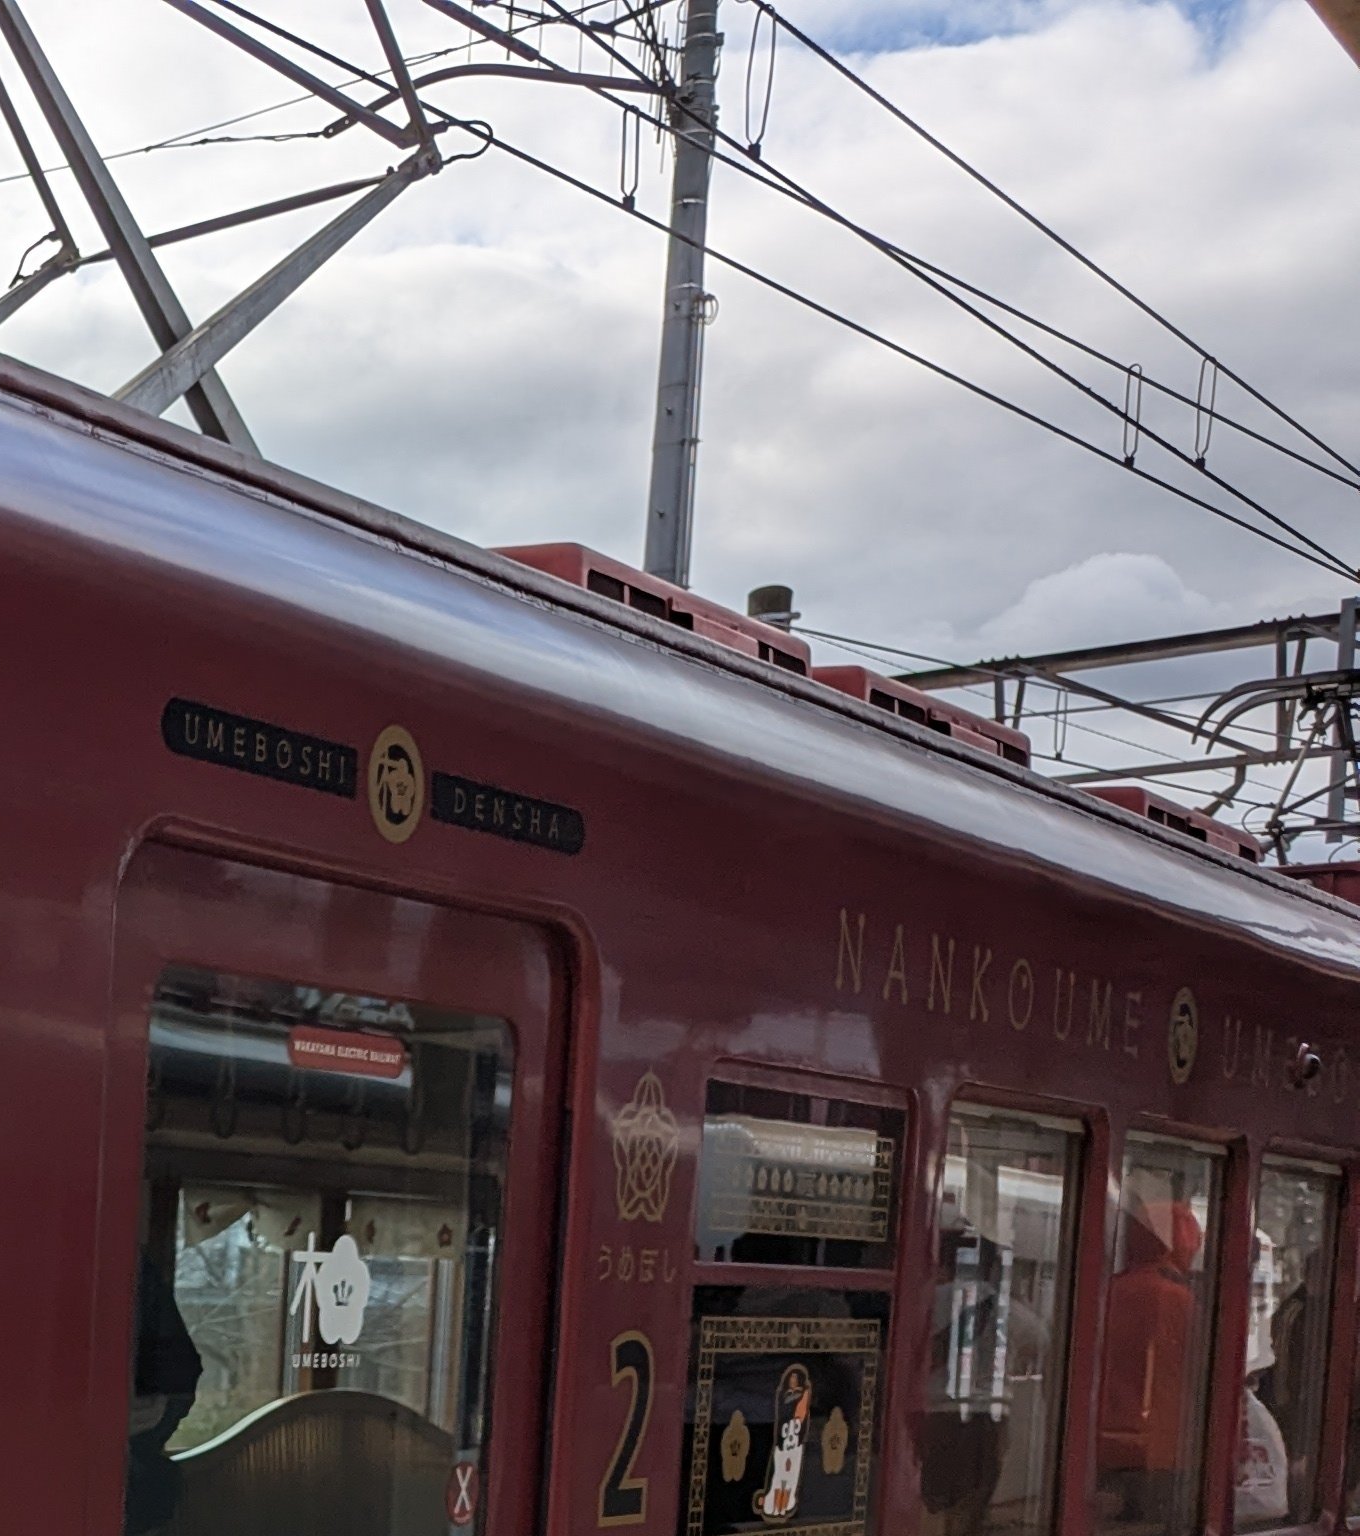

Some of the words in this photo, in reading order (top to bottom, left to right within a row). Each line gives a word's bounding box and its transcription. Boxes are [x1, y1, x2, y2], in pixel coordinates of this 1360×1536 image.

[183, 712, 347, 785] UMEBOSHI
[452, 787, 562, 841] DENSHA
[834, 906, 1142, 1059] NANKOUME
[292, 1352, 361, 1369] UMEBOSHI
[597, 1330, 654, 1528] 2
